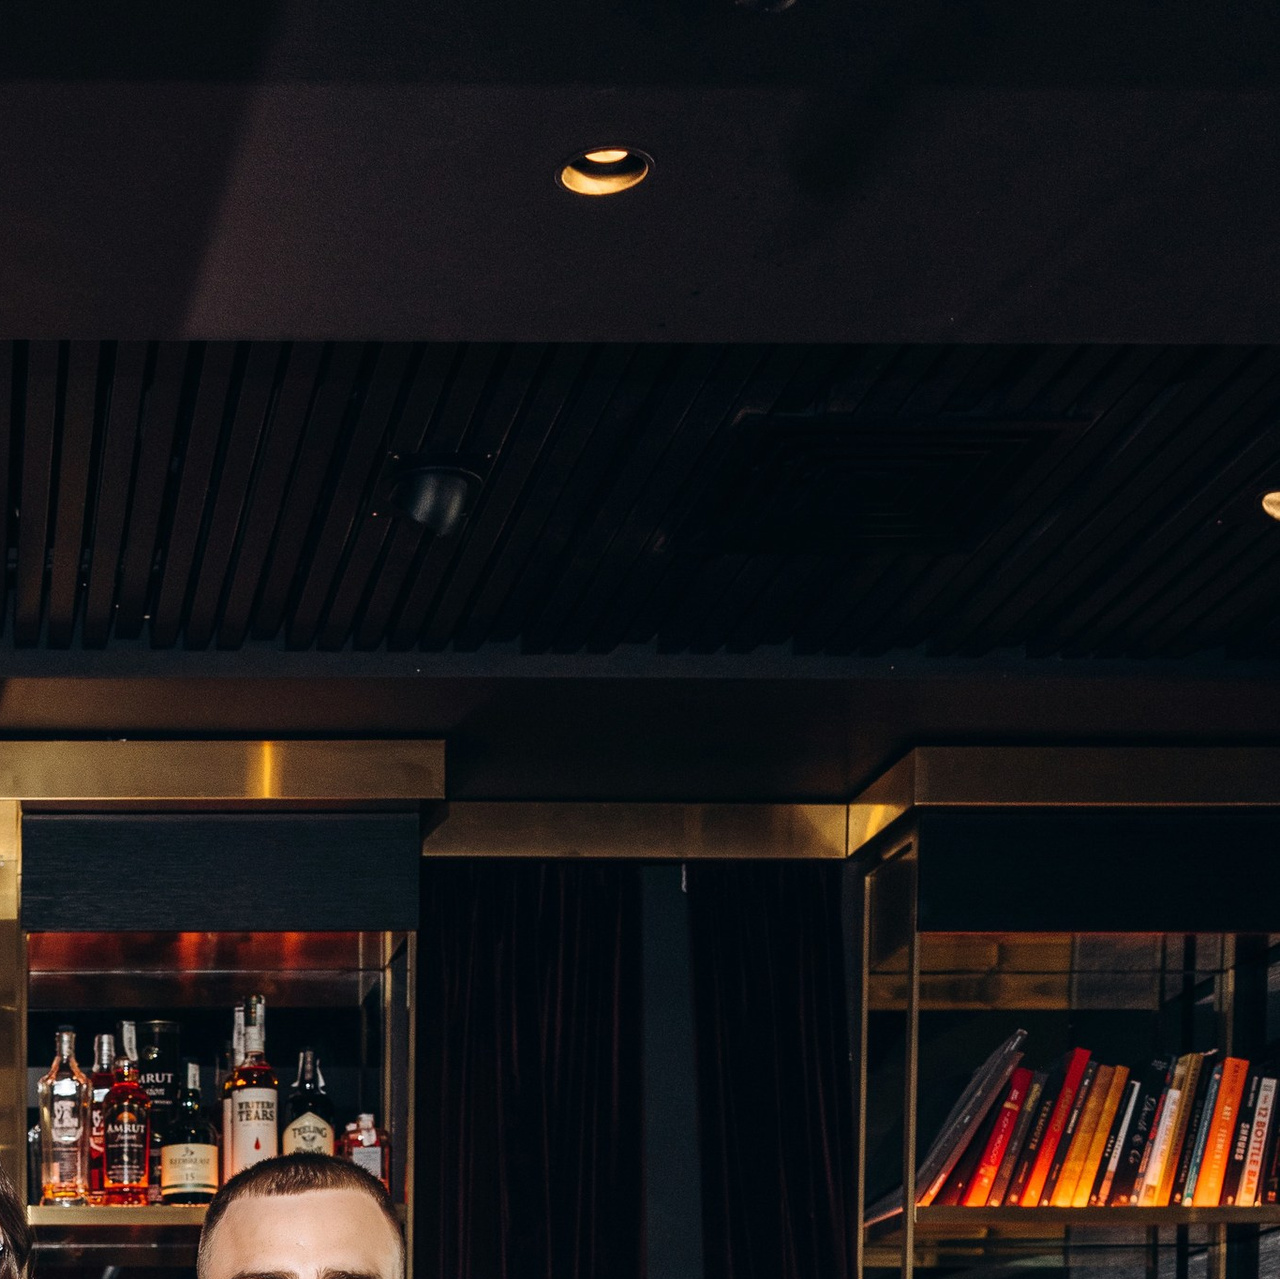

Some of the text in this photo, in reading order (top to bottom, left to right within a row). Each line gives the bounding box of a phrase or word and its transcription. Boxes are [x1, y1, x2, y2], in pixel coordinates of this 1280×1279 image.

[238, 1110, 274, 1122] TEARS
[1257, 1106, 1268, 1117] 12
[107, 1124, 145, 1133] AMRUT
[291, 1126, 327, 1138] TEELING
[1028, 1098, 1052, 1151] VERMOUTH
[1233, 1121, 1250, 1161] SHRUBS
[1247, 1120, 1267, 1166] BOTTLE
[1242, 1168, 1258, 1195] BAR
